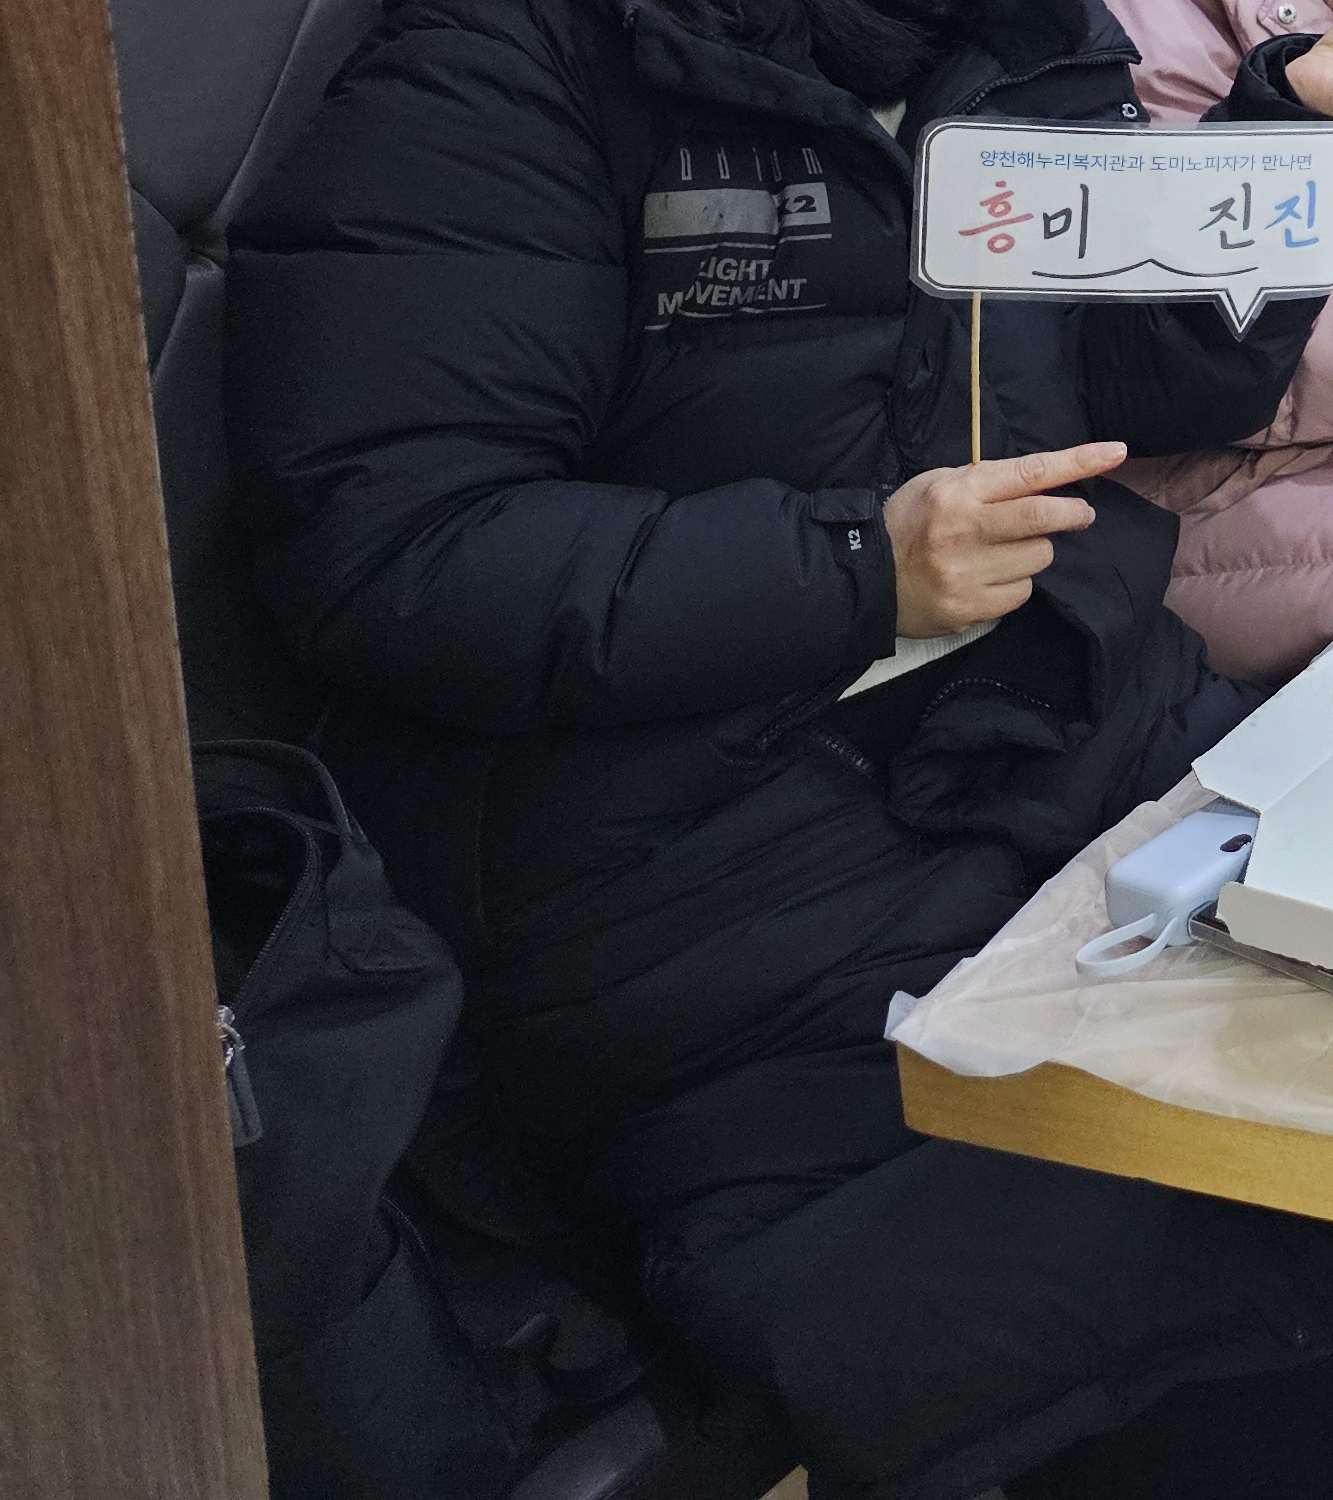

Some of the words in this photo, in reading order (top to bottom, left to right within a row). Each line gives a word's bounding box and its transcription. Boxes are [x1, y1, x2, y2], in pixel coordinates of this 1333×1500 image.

[980, 150, 1146, 172] 양천해누리복지관과
[1149, 153, 1256, 173] 도미노피자가
[1262, 153, 1313, 172] 만나면
[958, 180, 1089, 259] 흥미
[1198, 180, 1320, 250] 진진
